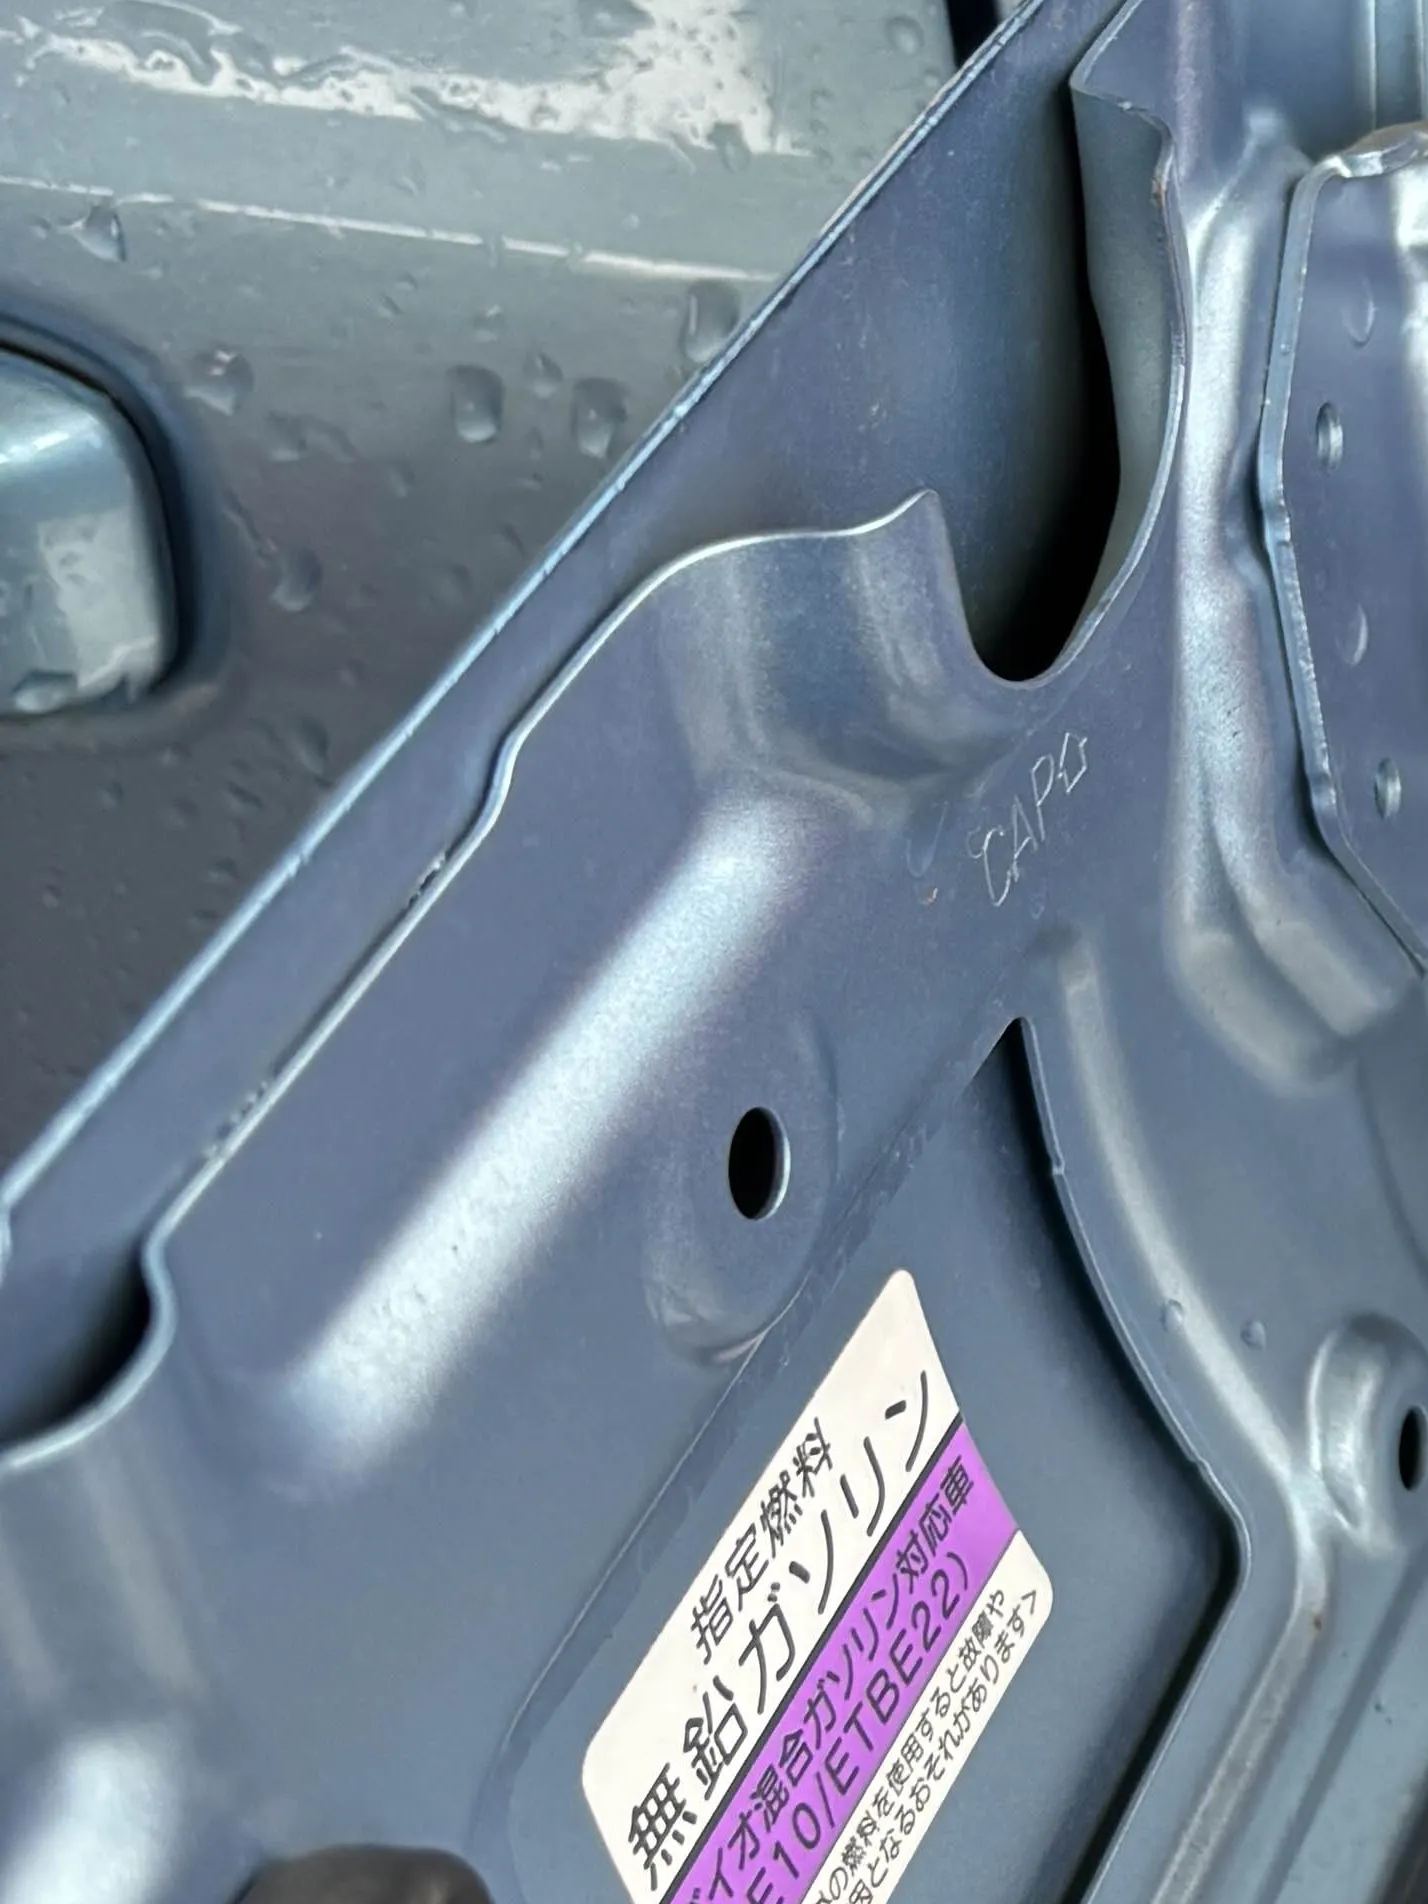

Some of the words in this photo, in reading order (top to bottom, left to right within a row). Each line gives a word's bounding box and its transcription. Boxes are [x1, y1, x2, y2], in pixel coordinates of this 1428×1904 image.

[627, 1369, 930, 1892] 無鉛ガソリン
[690, 1415, 834, 1666] 指定燃料
